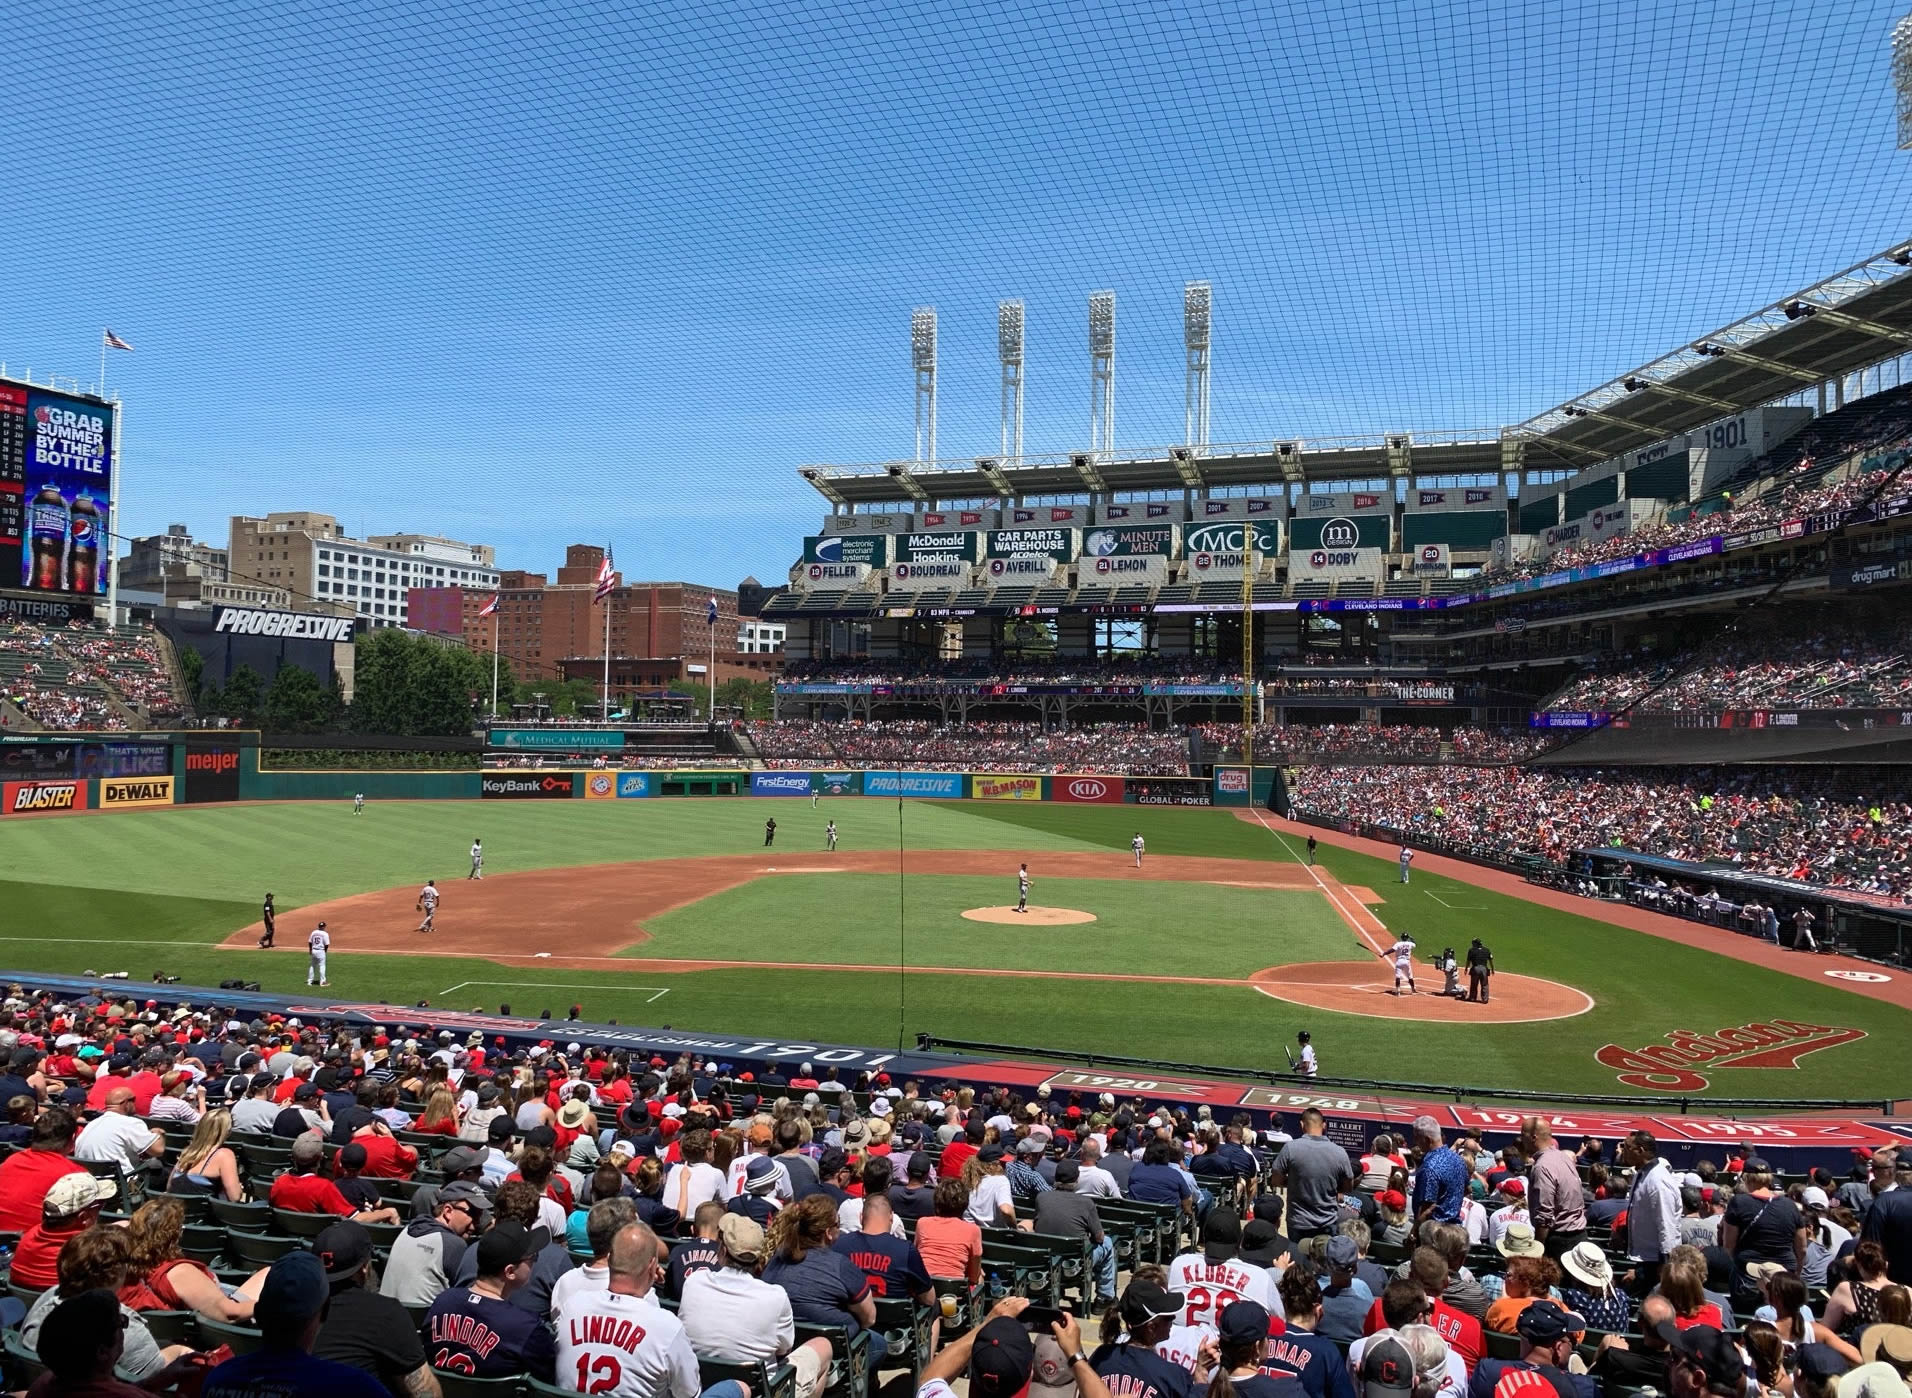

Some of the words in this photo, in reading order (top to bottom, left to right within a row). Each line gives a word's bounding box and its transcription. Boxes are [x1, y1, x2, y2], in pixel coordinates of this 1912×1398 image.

[49, 408, 104, 434] GRAB
[37, 421, 104, 445] SUMMER
[1705, 417, 1747, 449] 1901
[36, 434, 57, 450] BY
[60, 438, 92, 457] THE
[36, 448, 103, 474] BOTTLE
[908, 534, 964, 547] McDonald
[998, 532, 1020, 542] CAR
[1024, 530, 1062, 541] PARTS
[1120, 531, 1170, 542] MINUTE
[1554, 524, 1580, 544] HARDER
[994, 540, 1065, 552] WAREHOUSE
[1130, 542, 1160, 553] MEN
[842, 554, 871, 562] systems
[912, 552, 960, 563] Hopkins
[1198, 557, 1210, 565] 25
[1214, 554, 1245, 568] THOM
[1328, 552, 1359, 567] DOBY
[1425, 550, 1438, 558] 20
[1668, 551, 1694, 562] CLEVELAND
[1694, 546, 1712, 558] INDIANS
[823, 566, 856, 578] FELLER
[910, 564, 961, 577] BOUDREAU
[1006, 560, 1046, 574] AVERILL
[1112, 559, 1147, 572] LEMON
[1852, 572, 1872, 584] drug
[1872, 566, 1896, 580] mart
[216, 608, 354, 642] PROGRESSIVE
[1398, 687, 1414, 700] THE
[1416, 687, 1454, 700] CORNER
[1754, 712, 1764, 728] 12
[1776, 713, 1798, 726] LINDOR
[525, 736, 572, 746] MEDICAL
[576, 736, 609, 746] MUTUAL
[140, 746, 164, 755] WHAT
[121, 756, 164, 773] LIKE
[186, 752, 239, 774] meijer
[756, 776, 810, 790] FirstEnergy
[868, 778, 955, 792] PROGRESSIVE
[1220, 772, 1242, 785] drug
[482, 780, 540, 794] KeyBank
[1002, 780, 1036, 792] MASON
[1075, 782, 1100, 795] KIA
[1222, 782, 1247, 791] mart
[1139, 796, 1173, 805] GLOBAL
[1180, 796, 1210, 806] POKER
[551, 1028, 737, 1048] ESTABLISHED
[739, 1042, 898, 1066] 1901
[1594, 1018, 1870, 1092] Indians
[1070, 1074, 1158, 1090] 1920
[1267, 1093, 1360, 1111] 1948
[1340, 1122, 1362, 1131] ALERT
[1470, 1112, 1579, 1128] 194
[1684, 1122, 1799, 1138] 1995
[1498, 1214, 1530, 1225] RAMIREZ
[1687, 1230, 1715, 1242] LINDOR
[850, 1251, 892, 1272] INDOR
[1182, 1262, 1250, 1293] KLUBER
[1436, 1313, 1463, 1339] ER
[432, 1314, 500, 1360] LINDOR
[570, 1316, 646, 1355] LINDOR
[1266, 1339, 1312, 1371] OMAR
[576, 1352, 622, 1396] 12
[1382, 1362, 1397, 1382] C
